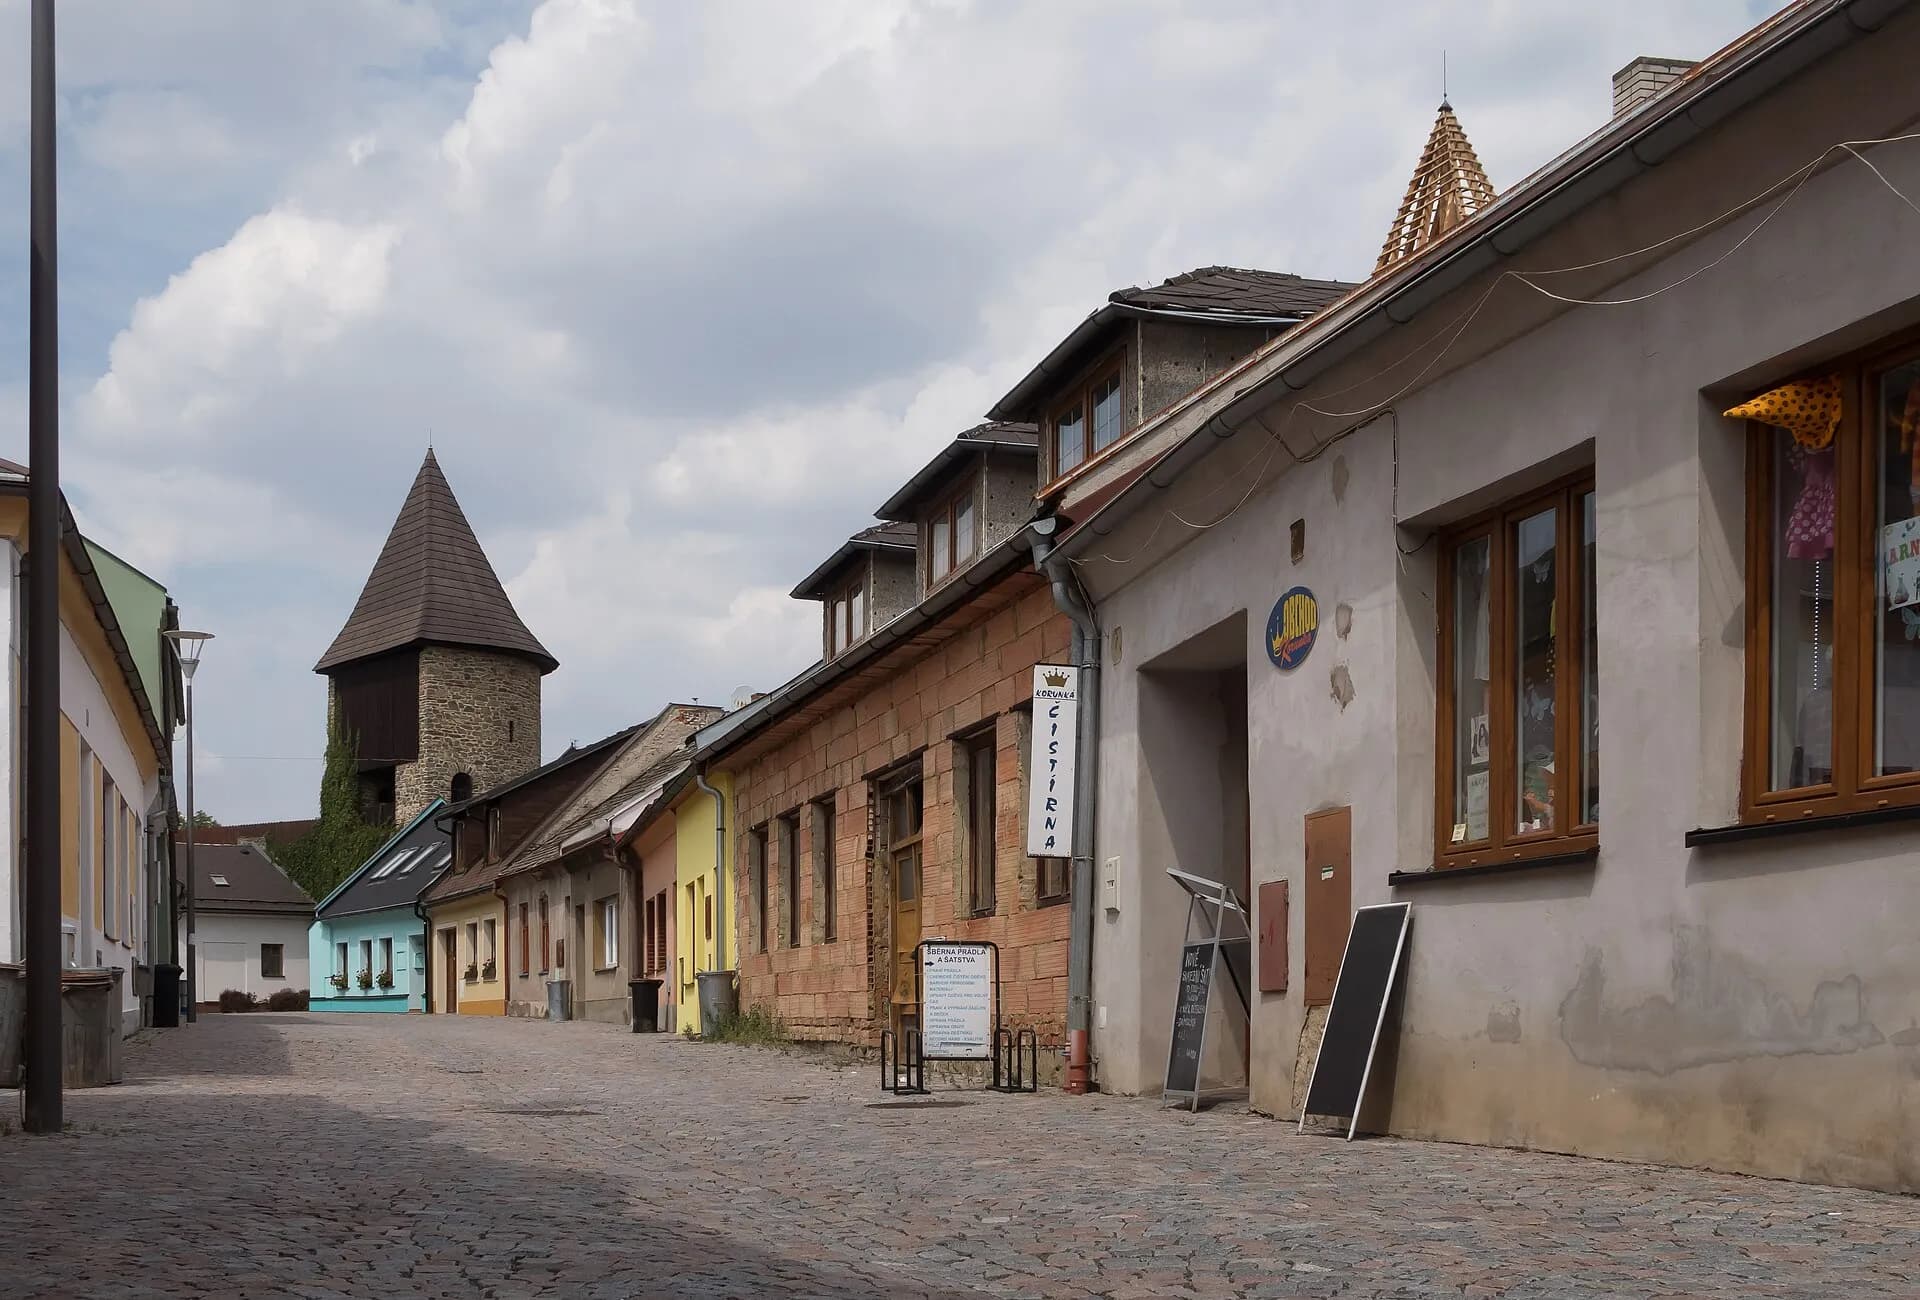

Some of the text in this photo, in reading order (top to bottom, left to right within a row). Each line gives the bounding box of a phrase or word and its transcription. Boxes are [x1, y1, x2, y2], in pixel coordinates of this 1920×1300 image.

[1283, 594, 1316, 640] OBCHOD
[1045, 701, 1060, 850] ČISTÍRNA
[957, 947, 986, 956] PRÁDLA
